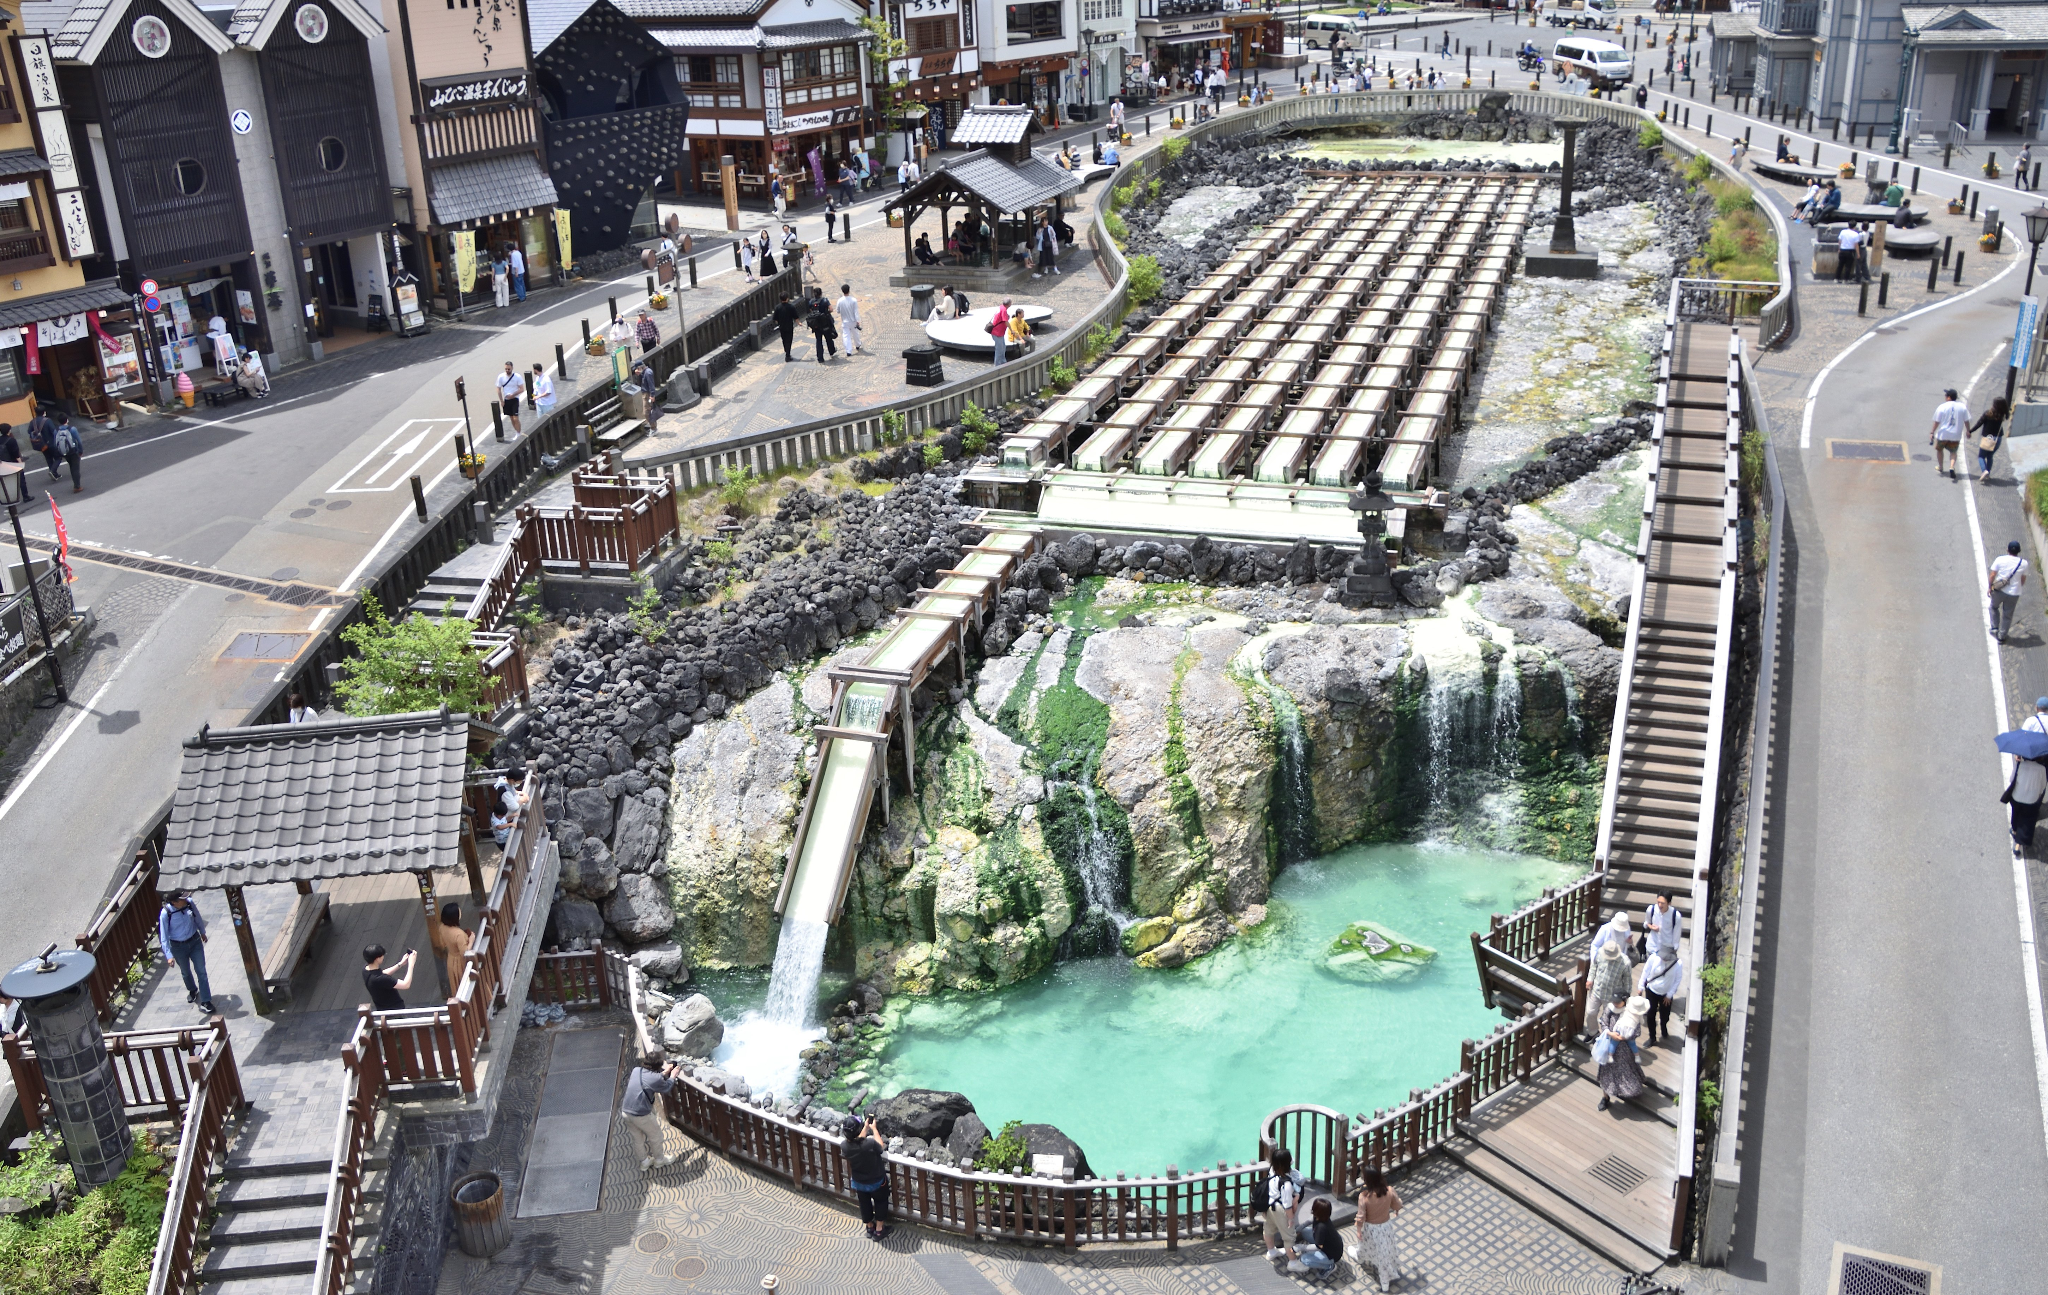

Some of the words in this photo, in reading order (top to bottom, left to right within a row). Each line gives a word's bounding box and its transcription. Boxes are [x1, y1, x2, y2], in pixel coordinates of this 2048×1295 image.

[29, 43, 54, 103] 白旗源泉
[430, 74, 527, 107] 山びこ温泉まんじゅう
[145, 284, 155, 292] 20
